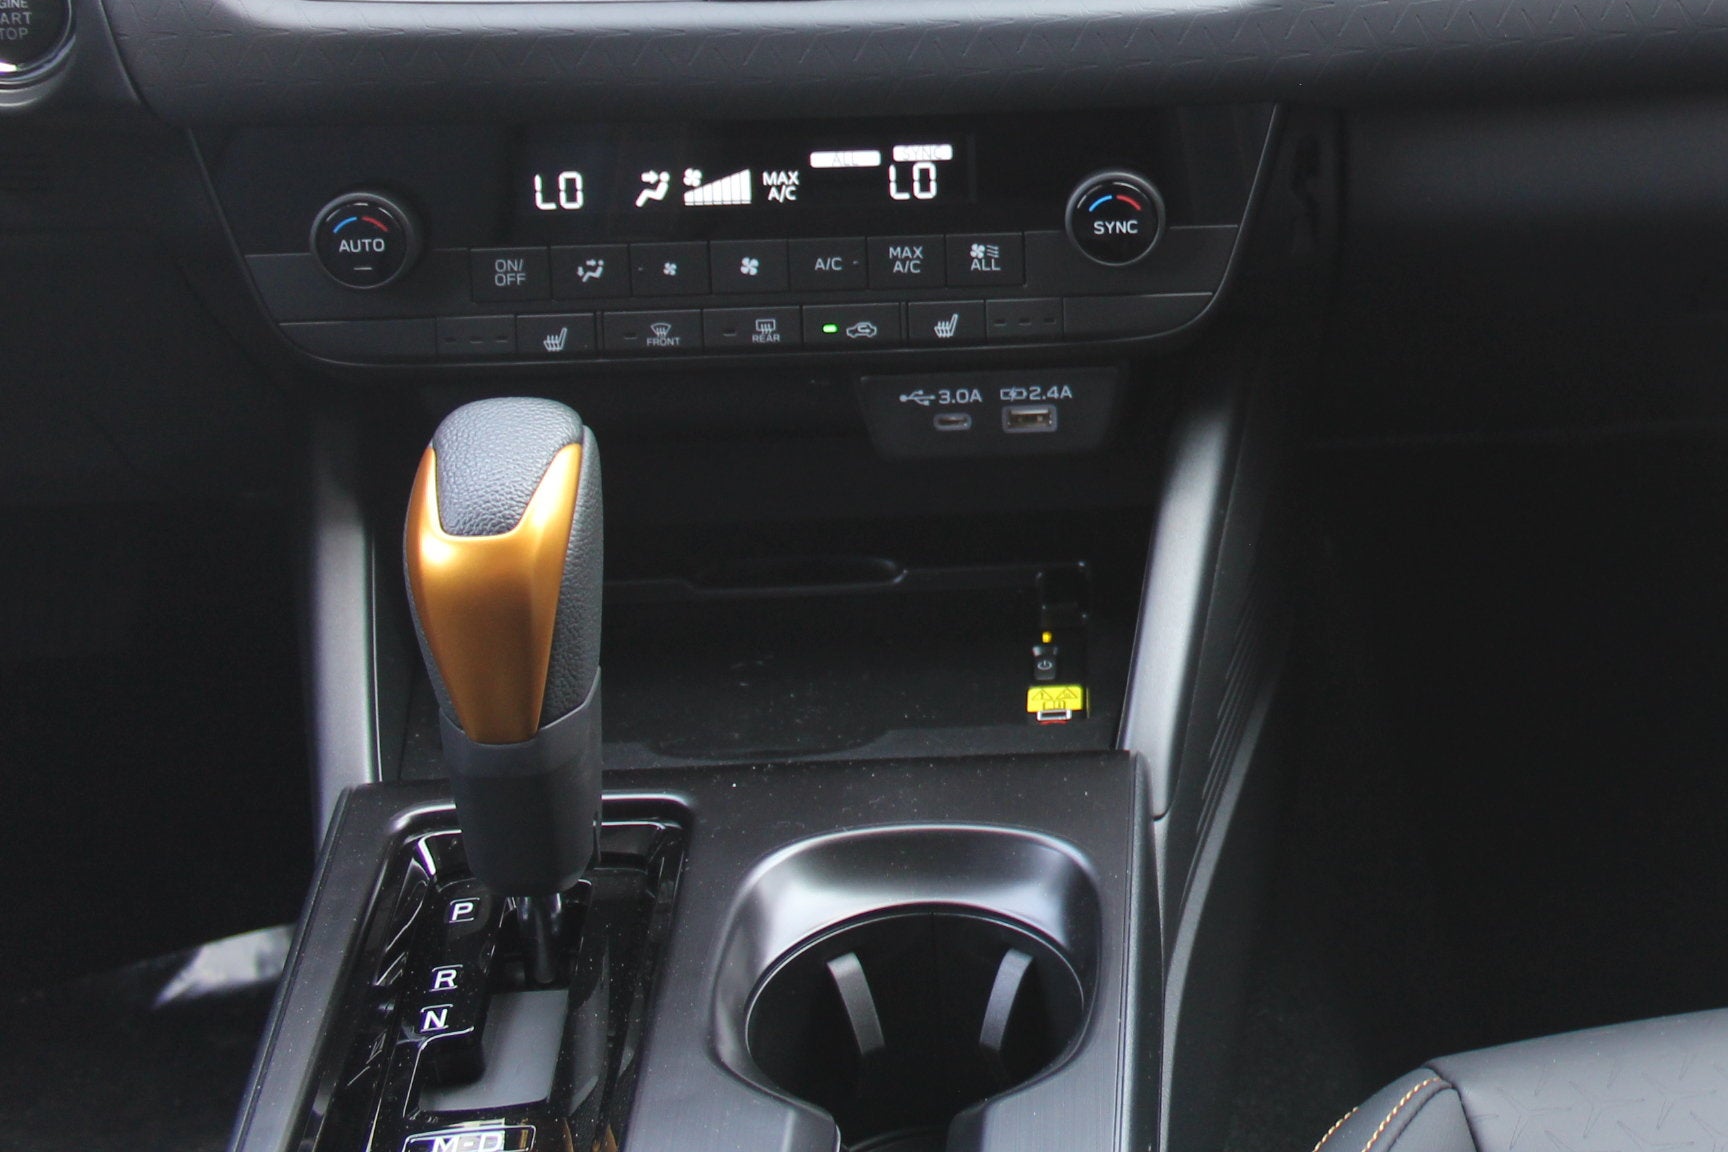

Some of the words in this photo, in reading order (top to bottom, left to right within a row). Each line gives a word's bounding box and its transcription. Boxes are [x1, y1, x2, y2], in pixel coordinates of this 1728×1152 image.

[762, 171, 799, 186] MAX
[889, 162, 937, 200] LO
[534, 171, 583, 210] LO
[768, 185, 797, 203] A/C
[1093, 220, 1138, 235] SYNC
[339, 238, 385, 253] AUTO
[889, 246, 923, 259] MAX
[495, 259, 524, 272] ON/
[814, 257, 843, 271] A/C
[893, 259, 921, 274] A/C
[970, 258, 1001, 271] ALL
[494, 272, 526, 287] OFF
[646, 337, 680, 347] FRONT
[752, 333, 781, 343] REAR
[938, 388, 982, 404] 3.0A
[1028, 385, 1073, 400] 2.4A
[452, 902, 474, 921] P
[434, 969, 458, 989] R
[423, 1008, 448, 1030] N
